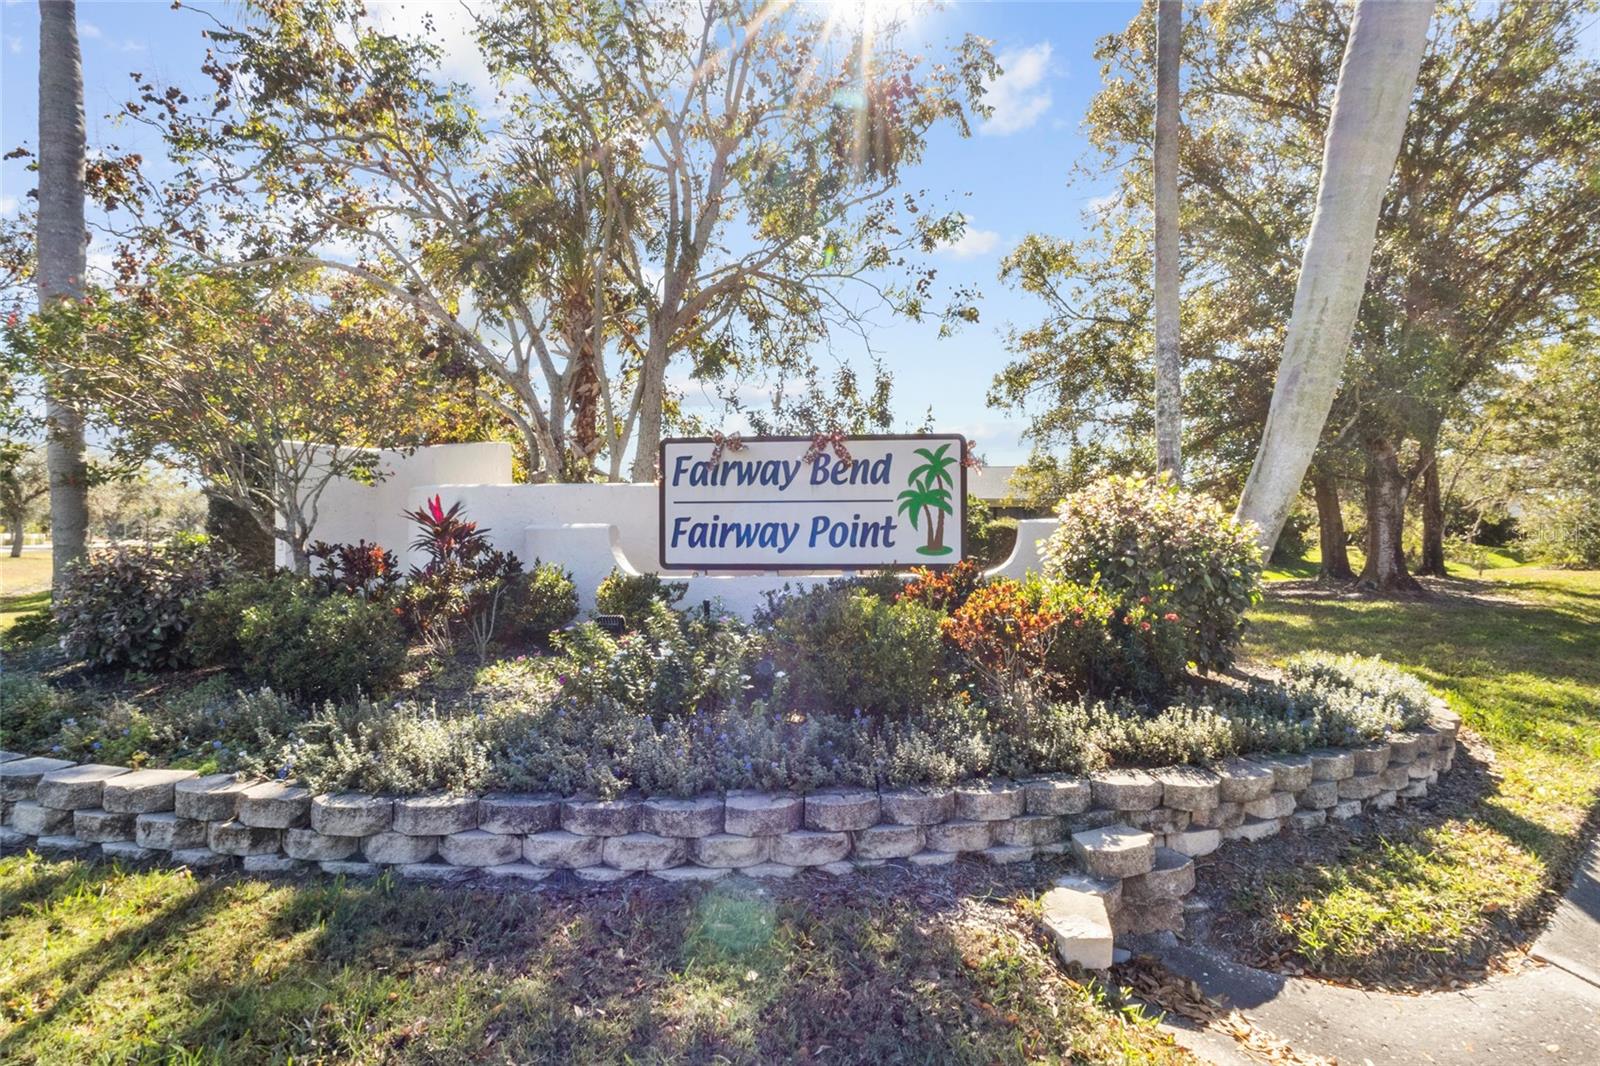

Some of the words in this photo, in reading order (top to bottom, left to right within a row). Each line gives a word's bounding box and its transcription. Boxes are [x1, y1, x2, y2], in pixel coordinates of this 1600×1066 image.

[672, 455, 801, 491] Fairway
[809, 453, 893, 485] Bend
[670, 515, 801, 554] Fairway
[808, 514, 898, 548] Point
